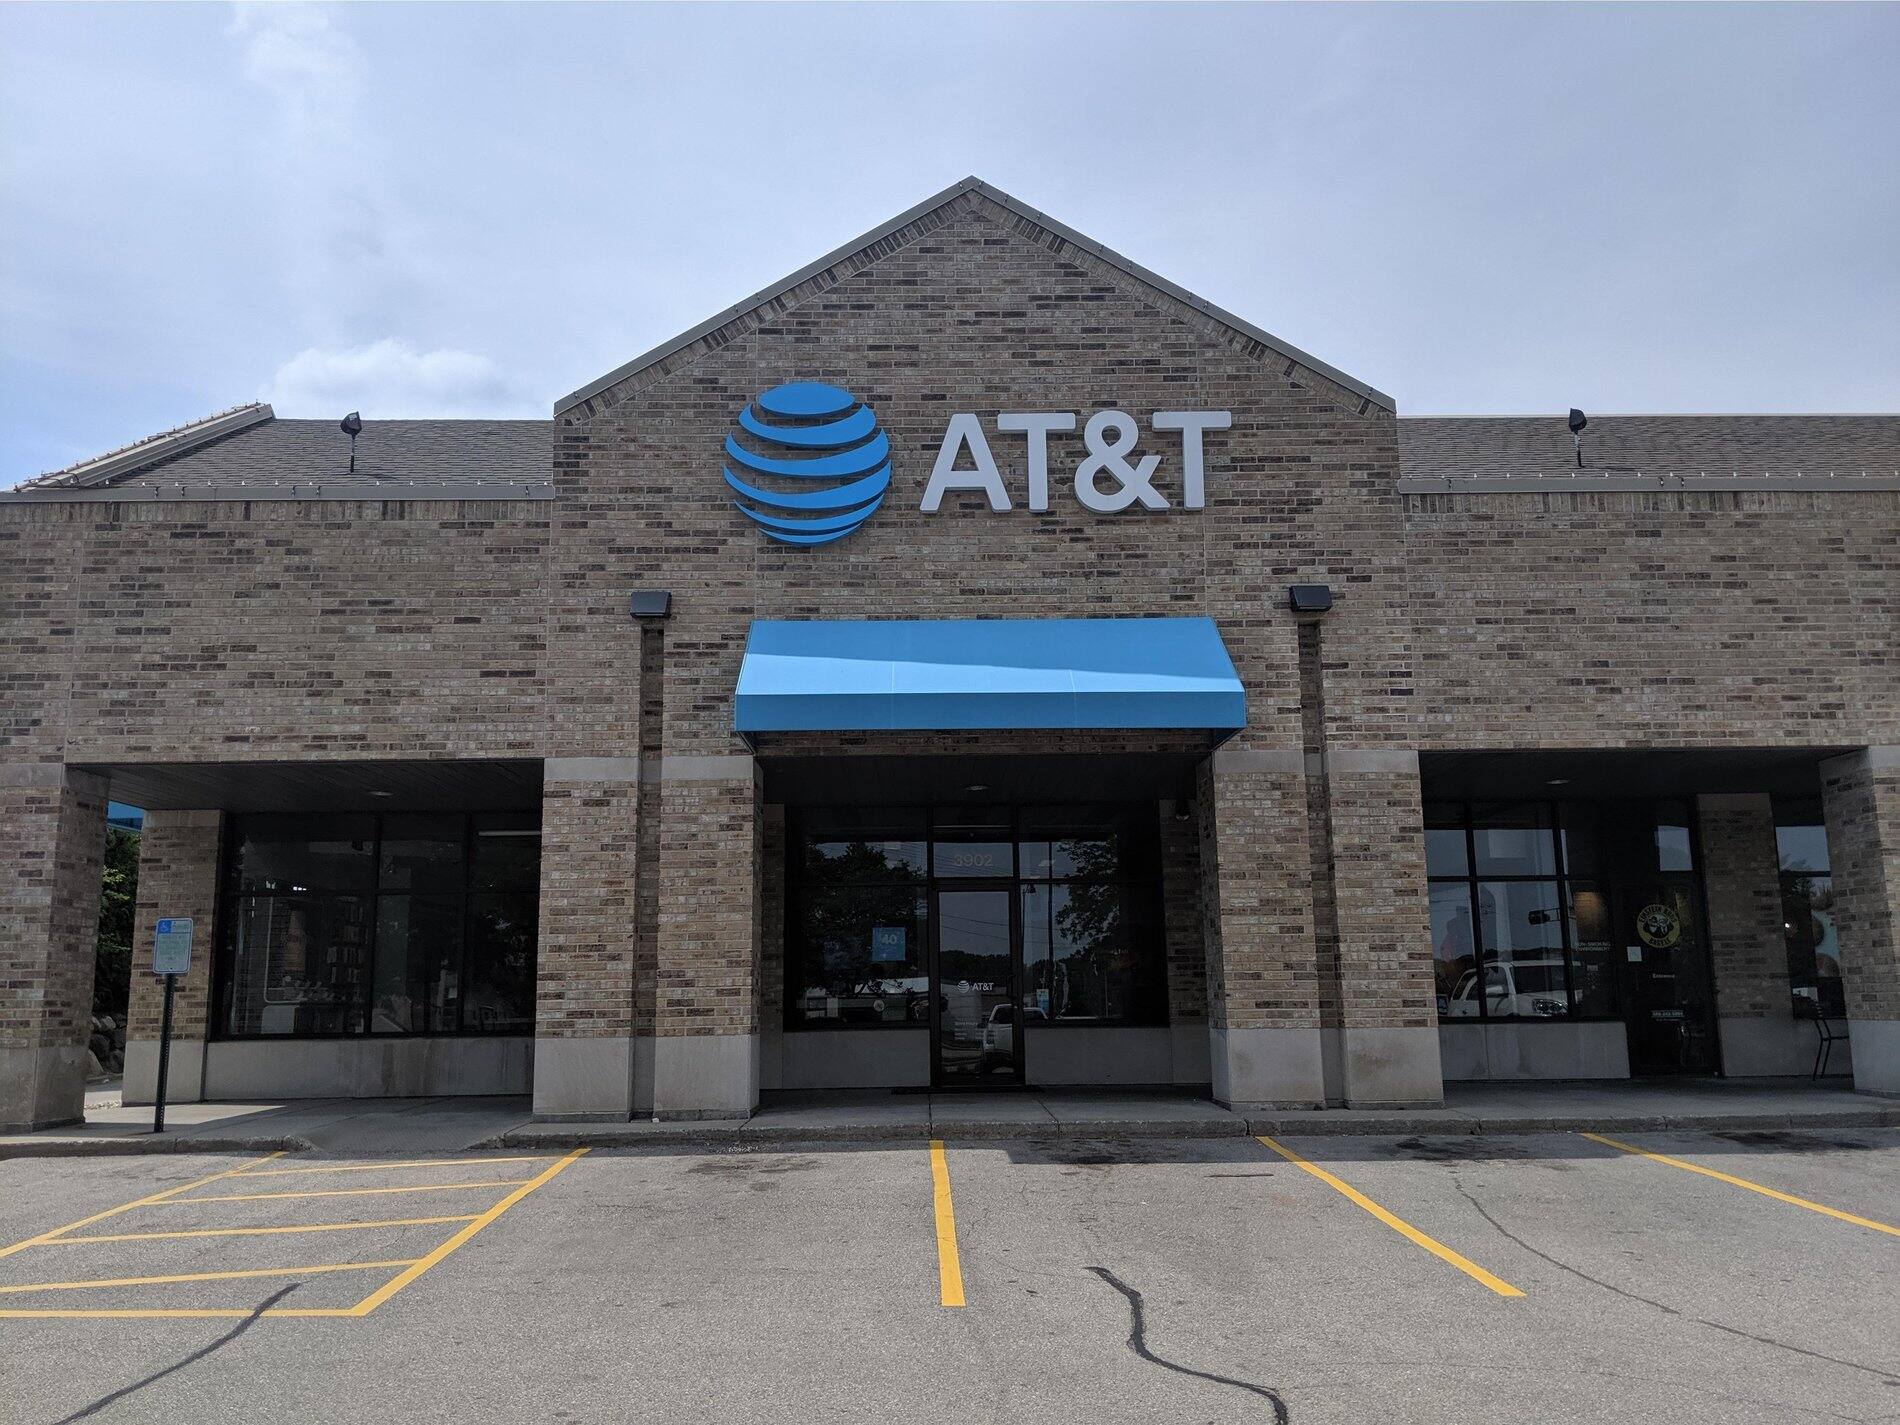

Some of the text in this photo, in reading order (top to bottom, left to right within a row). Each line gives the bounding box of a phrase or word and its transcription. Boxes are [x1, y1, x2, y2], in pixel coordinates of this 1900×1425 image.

[919, 410, 1232, 513] AT&T
[954, 854, 993, 867] 3902
[972, 982, 994, 991] AT&T
